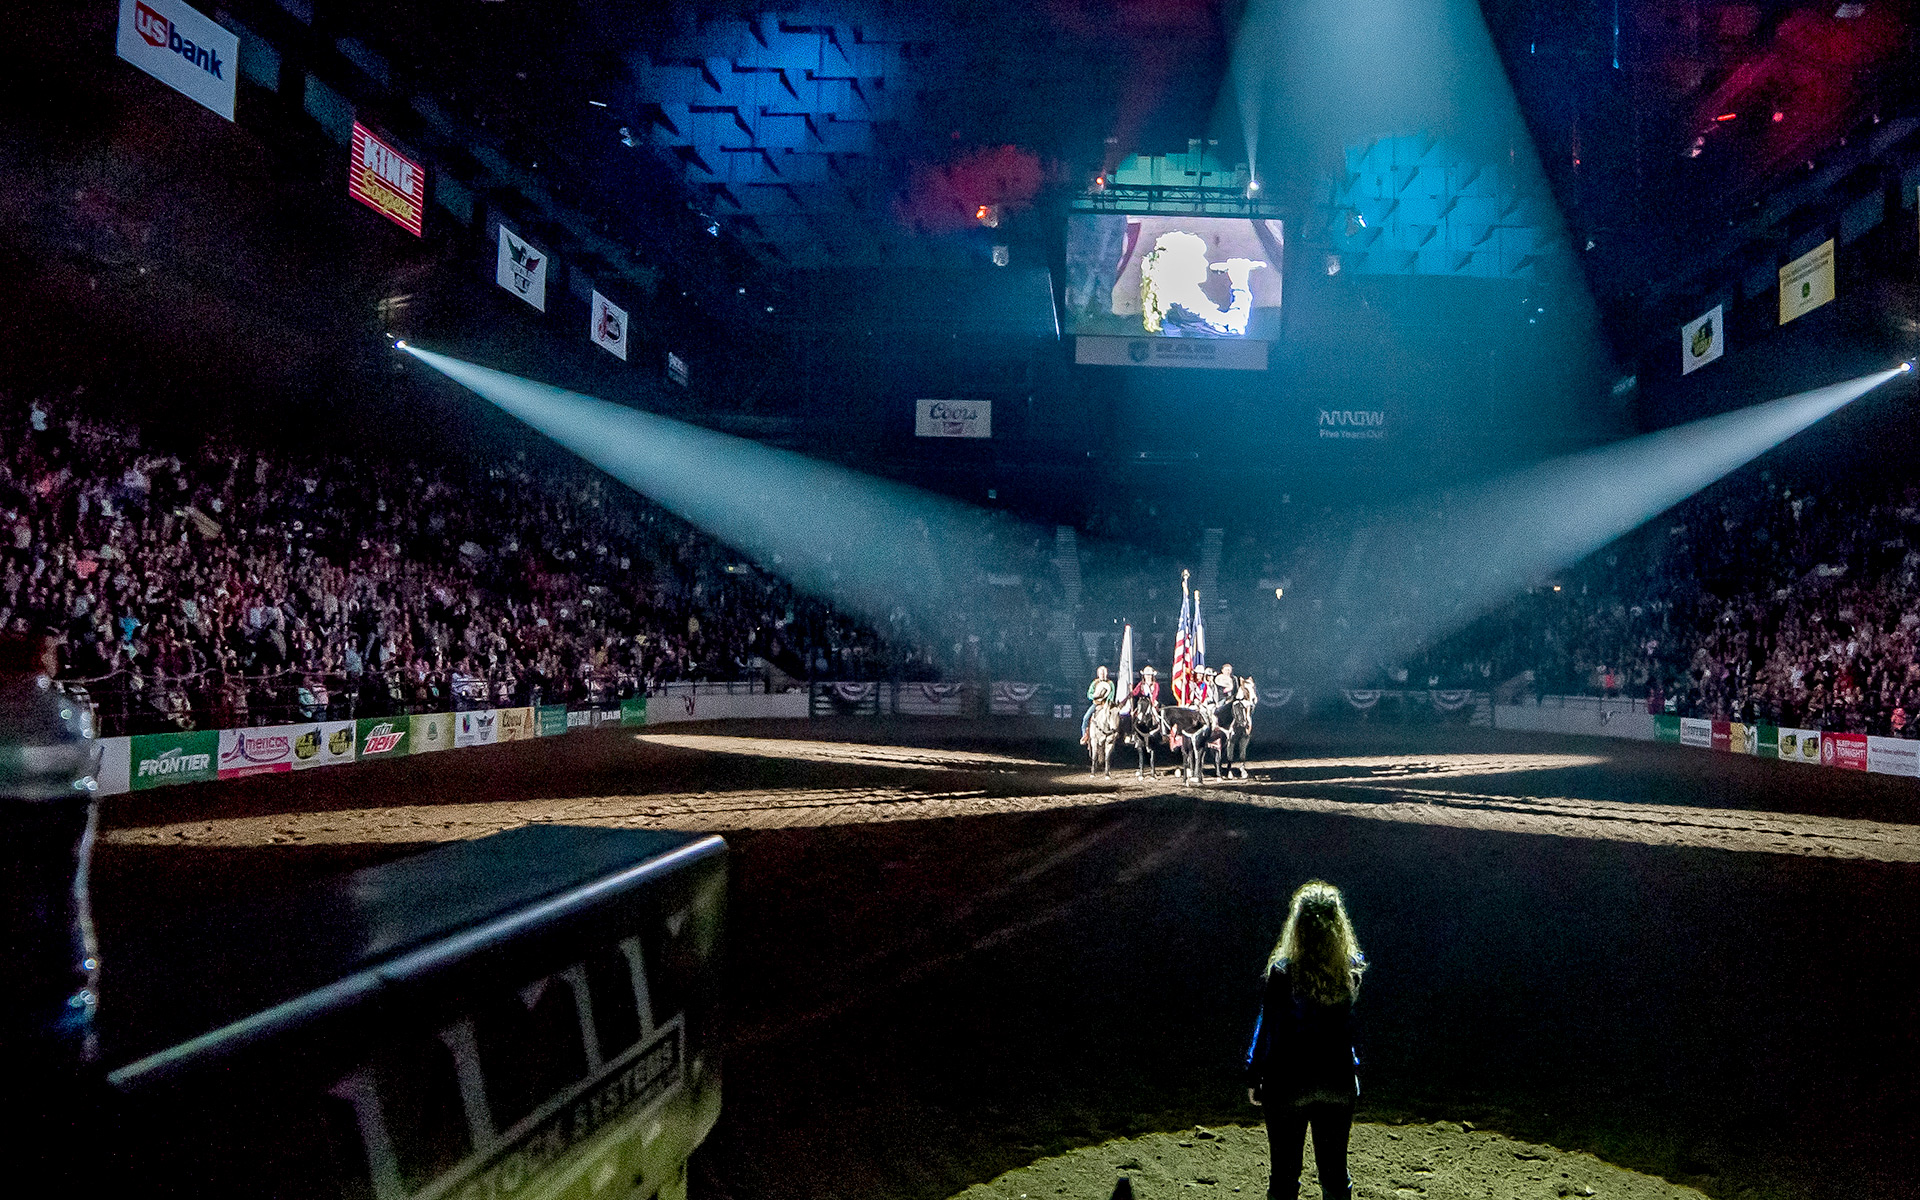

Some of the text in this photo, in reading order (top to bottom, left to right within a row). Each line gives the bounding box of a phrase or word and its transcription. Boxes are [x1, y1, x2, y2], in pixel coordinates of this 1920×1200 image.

[363, 136, 413, 195] KING
[930, 402, 978, 420] Coors
[365, 733, 402, 753] DEW
[138, 754, 210, 777] FRONTIER
